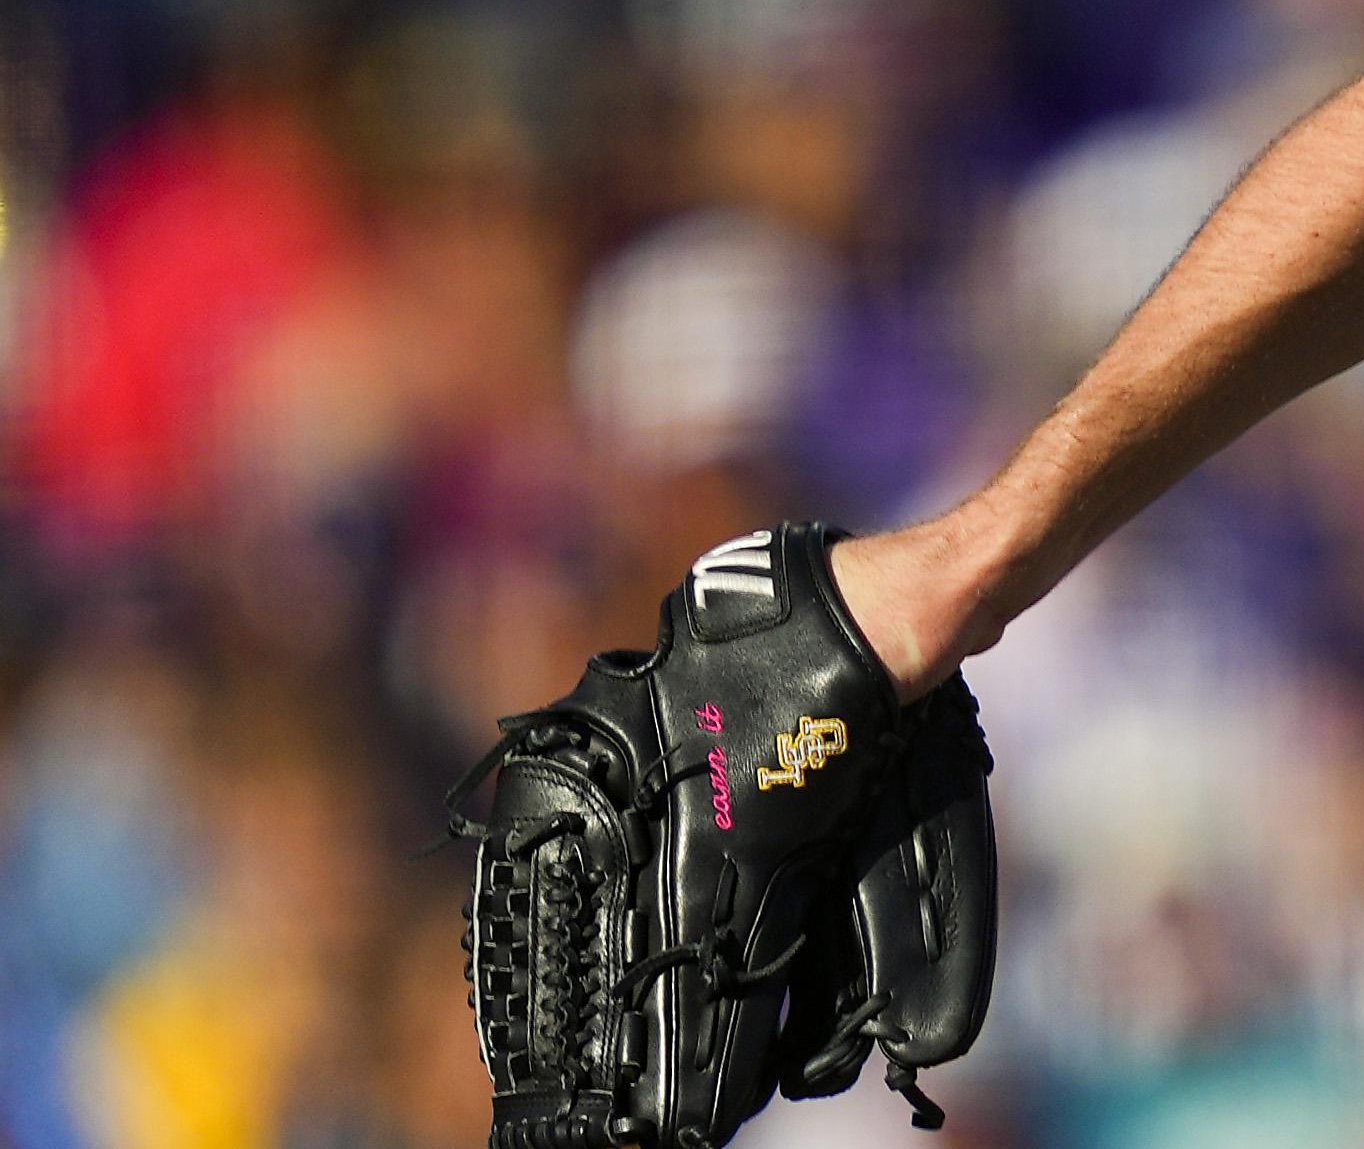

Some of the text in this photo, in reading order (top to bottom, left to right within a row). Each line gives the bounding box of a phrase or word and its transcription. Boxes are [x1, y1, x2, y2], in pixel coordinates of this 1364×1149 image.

[694, 701, 734, 831] earn it
[757, 716, 848, 790] LSU
